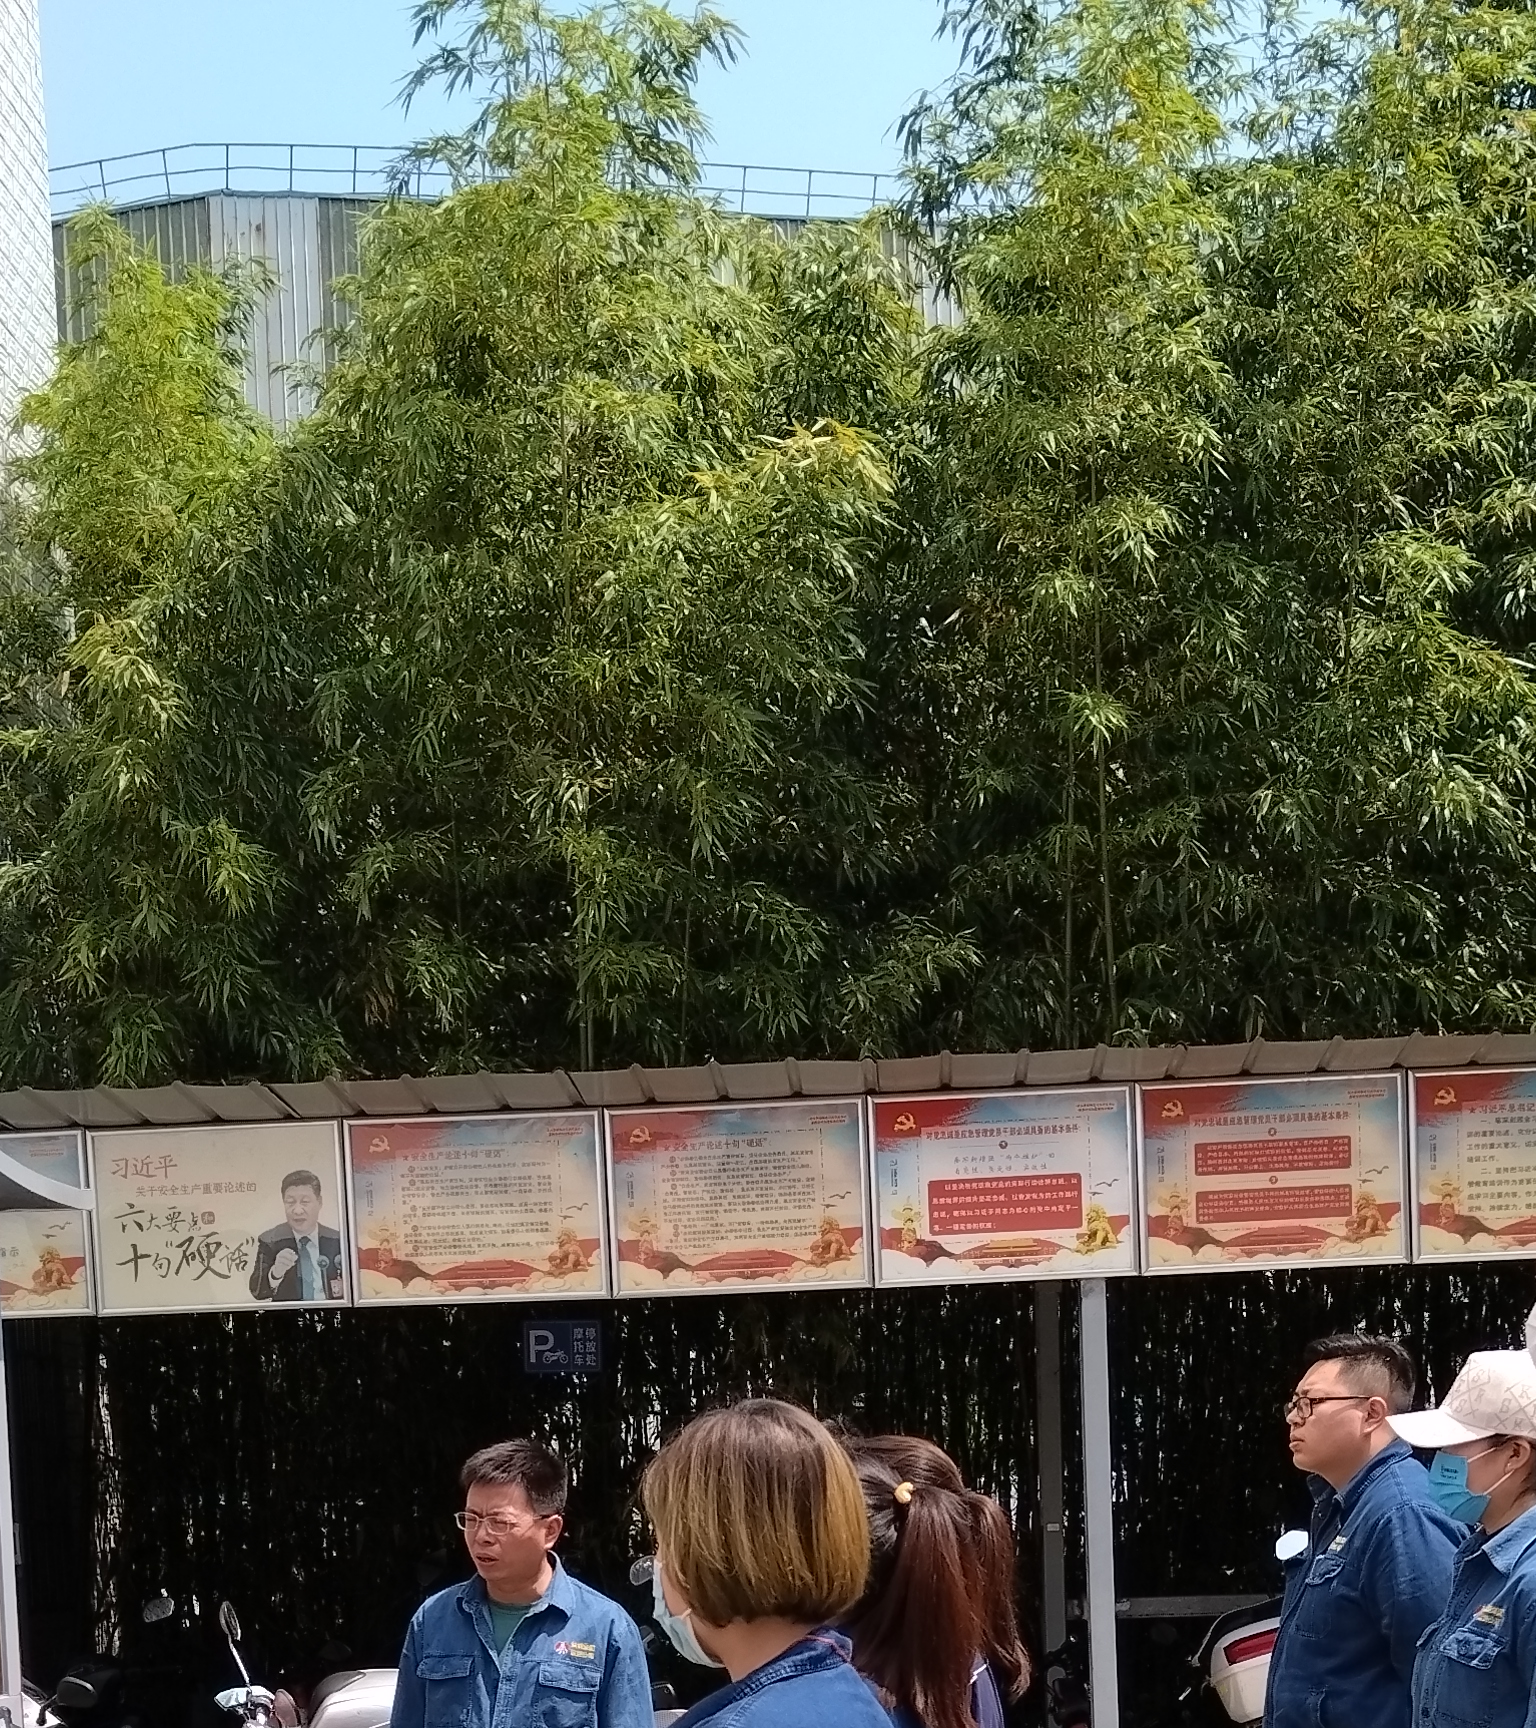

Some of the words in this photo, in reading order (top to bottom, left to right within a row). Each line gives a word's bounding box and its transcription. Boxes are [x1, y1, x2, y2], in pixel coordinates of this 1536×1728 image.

[111, 1154, 178, 1179] 习近平
[136, 1181, 257, 1197] 关于安全生产重要论述的
[529, 1329, 555, 1363] P
